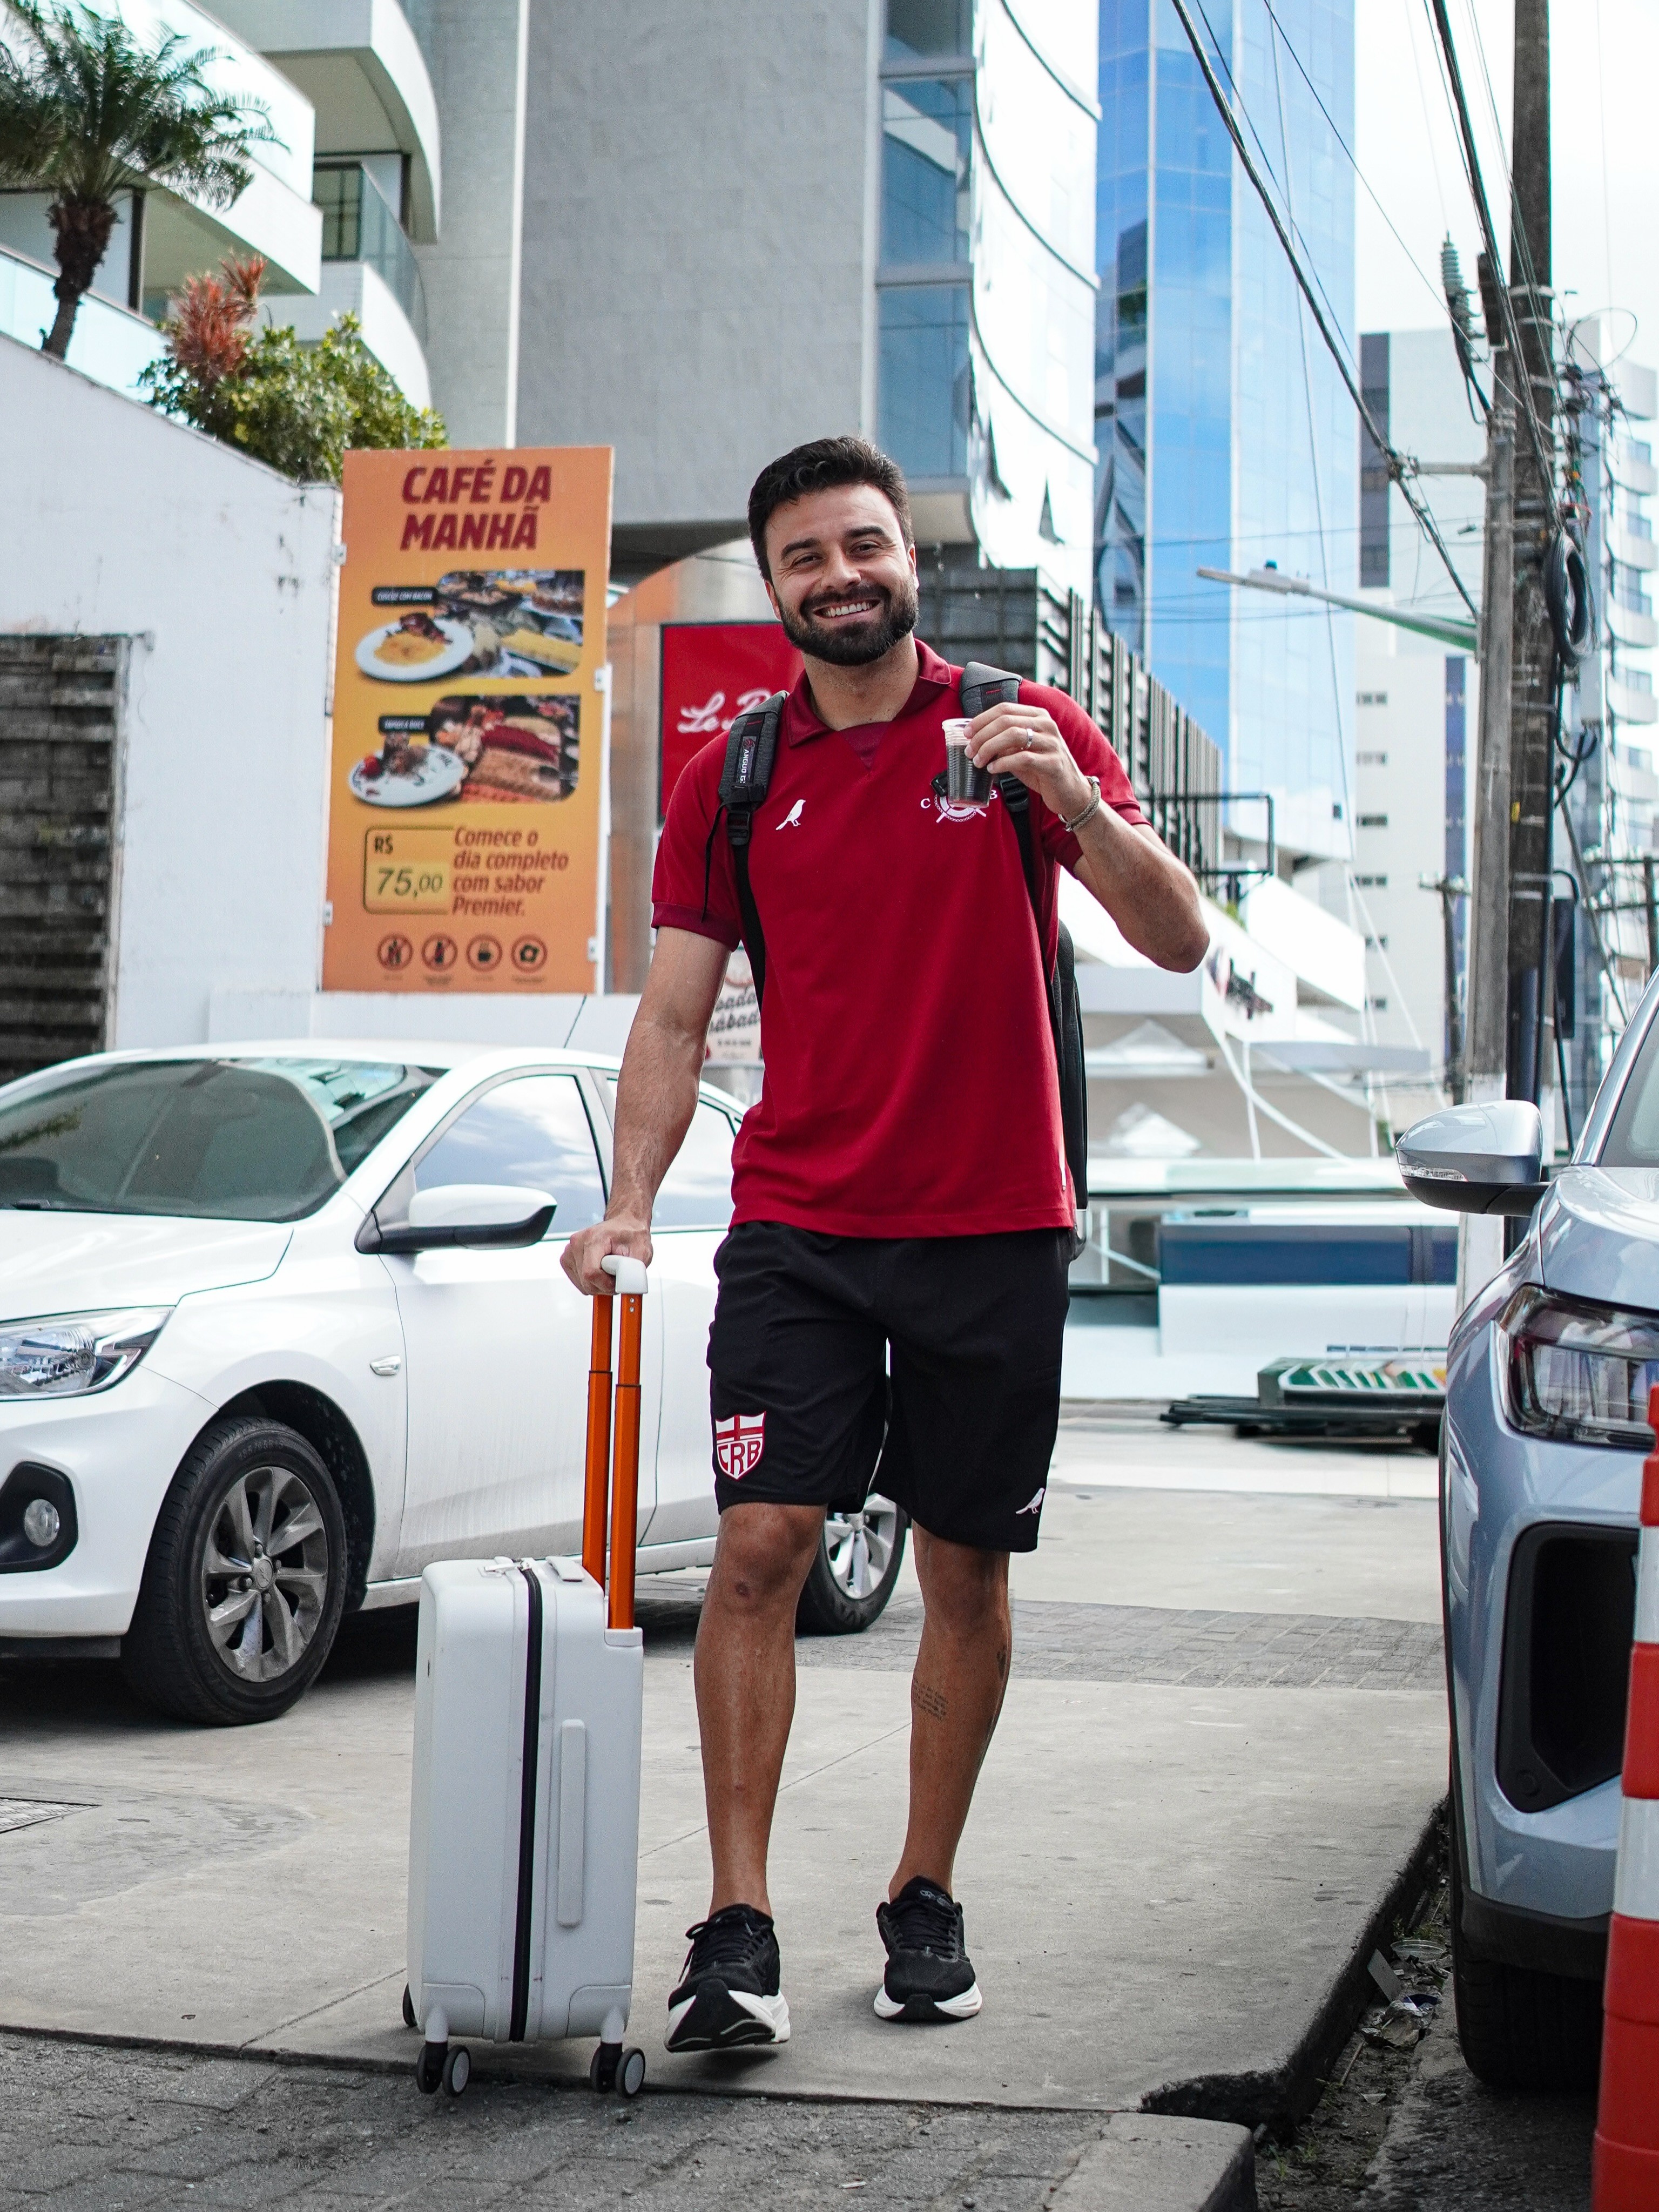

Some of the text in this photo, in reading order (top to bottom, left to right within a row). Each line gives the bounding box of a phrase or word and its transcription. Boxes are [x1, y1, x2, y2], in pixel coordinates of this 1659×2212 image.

[402, 458, 551, 503] CAFÉ DA
[400, 505, 539, 551] MANHÃ
[920, 798, 930, 808] C
[374, 834, 393, 854] R$
[455, 826, 538, 847] Comece o
[454, 850, 569, 871] dia completo
[378, 867, 443, 899] 75,00
[453, 873, 545, 894] com sabor
[718, 1441, 760, 1475] CRB
